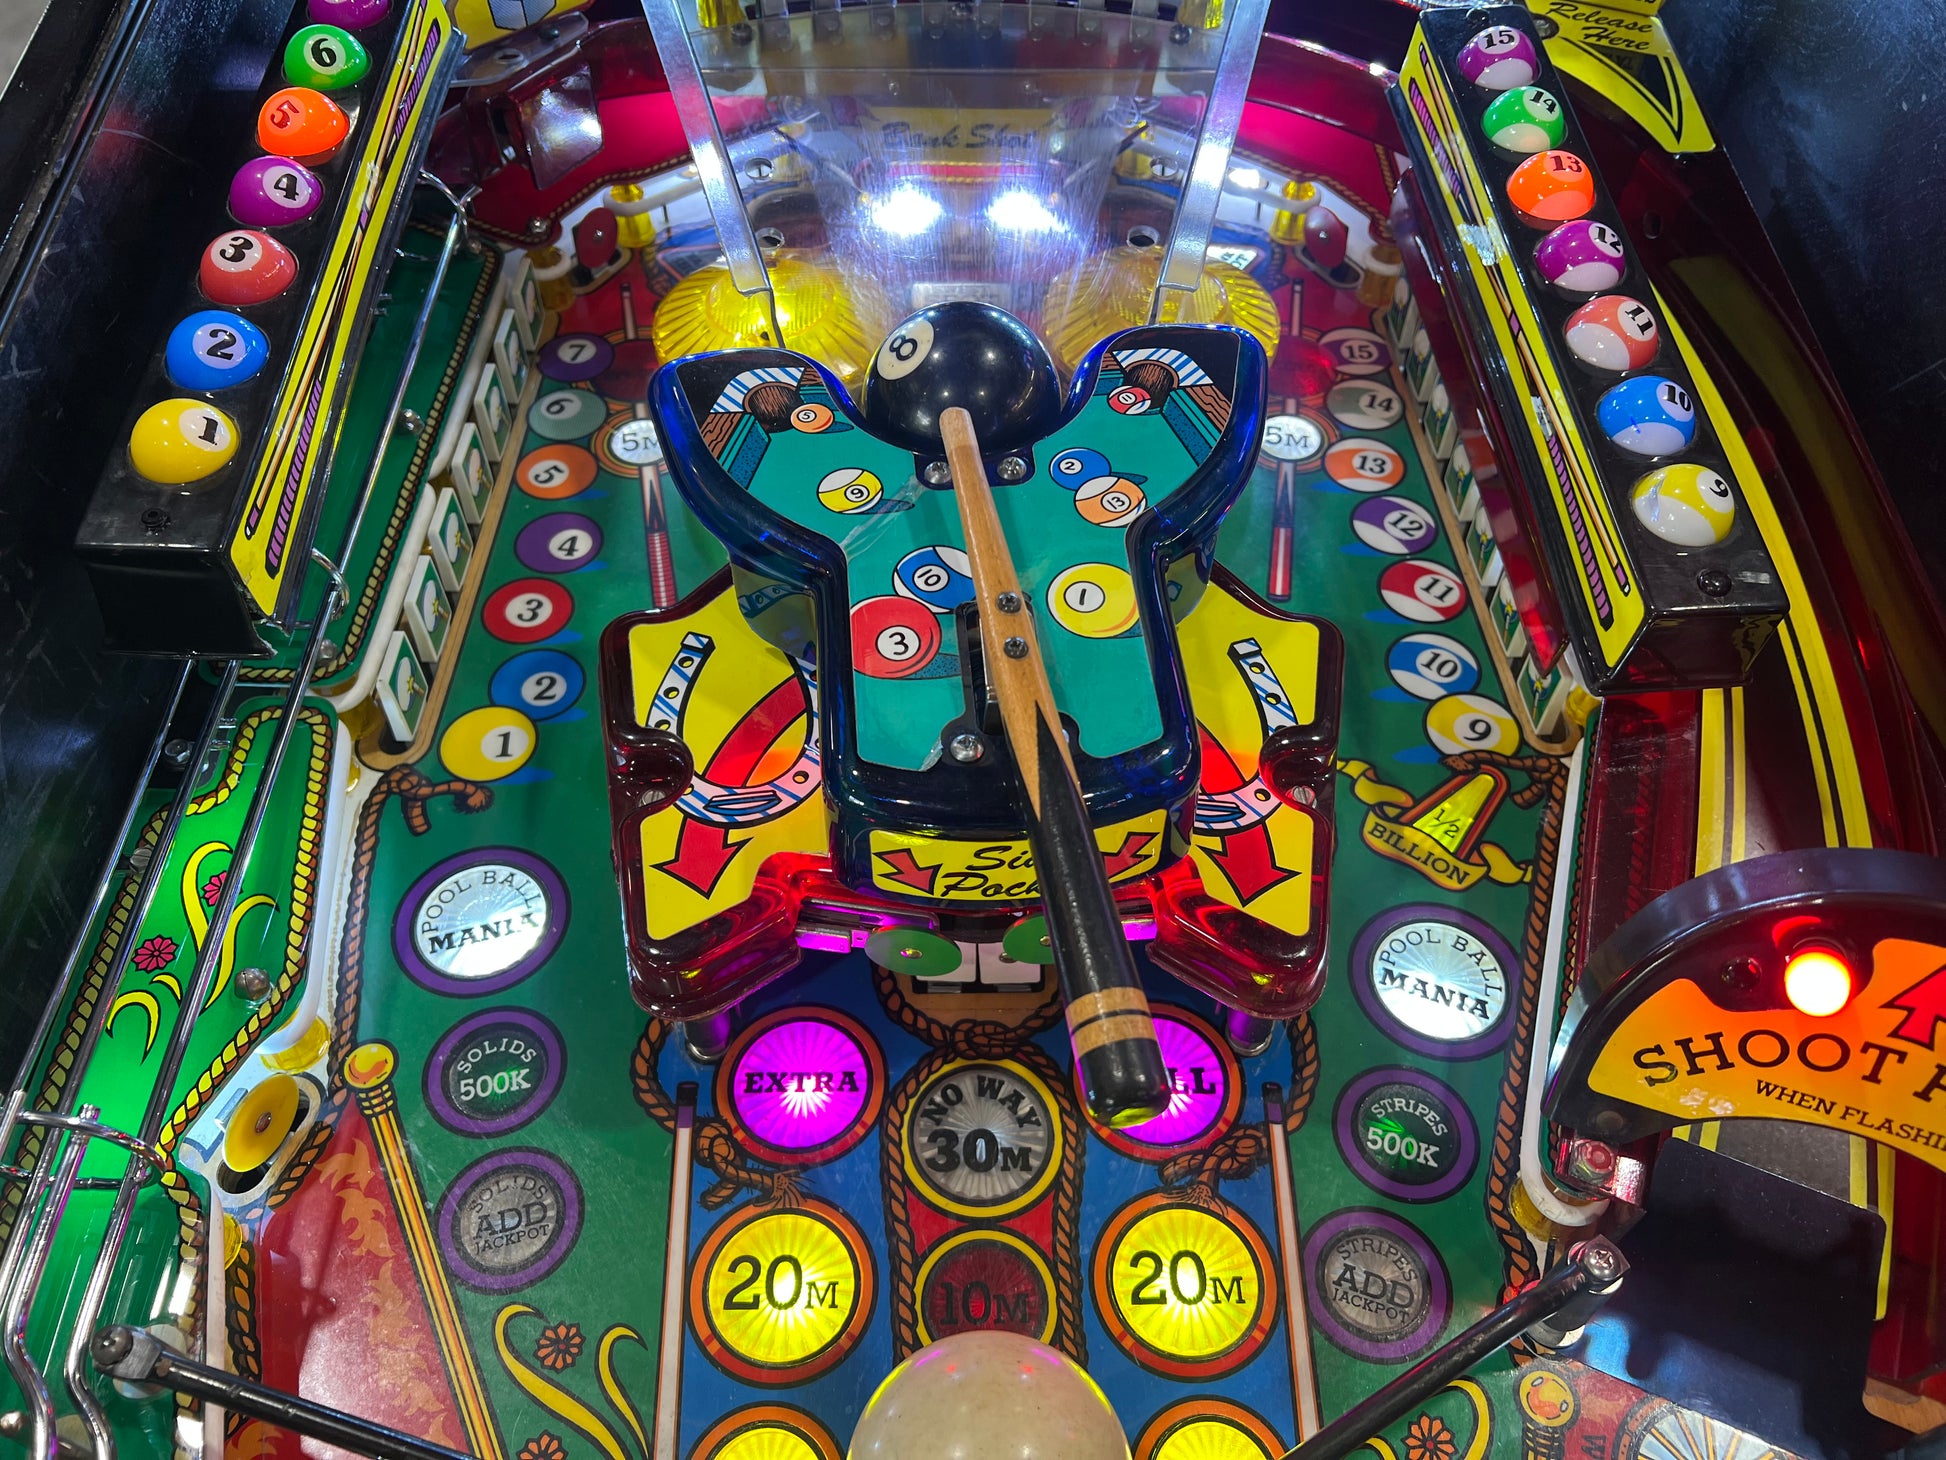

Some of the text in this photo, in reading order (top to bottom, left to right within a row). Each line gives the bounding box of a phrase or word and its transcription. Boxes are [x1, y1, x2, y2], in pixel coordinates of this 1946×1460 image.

[1545, 2, 1653, 33] Release
[1483, 29, 1516, 49] 15
[1581, 26, 1650, 50] Here
[310, 38, 337, 67] 6
[270, 100, 300, 129] 5
[1528, 89, 1556, 115] 14
[1550, 155, 1582, 174] 13
[273, 173, 300, 202] 4
[219, 236, 254, 264] 3
[1593, 226, 1623, 253] 12
[1625, 304, 1654, 336] 11
[208, 328, 235, 361] 2
[568, 344, 587, 362] 7
[890, 335, 918, 361] 8
[1346, 345, 1374, 360] 15
[546, 398, 574, 415] 6
[1366, 393, 1394, 412] 14
[1663, 383, 1693, 412] 10
[801, 411, 812, 421] 5
[198, 416, 218, 447] 1
[621, 432, 662, 451] 5M
[1264, 426, 1309, 448] 5M
[534, 464, 566, 484] 5
[1064, 461, 1076, 471] 2
[1356, 455, 1387, 474] 13
[850, 488, 864, 499] 9
[1709, 479, 1730, 498] 9
[1106, 496, 1126, 510] 13
[1388, 512, 1424, 537] 12
[557, 535, 579, 556] 4
[919, 569, 942, 585] 10
[1419, 577, 1455, 603] 11
[516, 598, 544, 623] 3
[1078, 587, 1088, 607] 1
[889, 632, 910, 656] 3
[1420, 650, 1459, 679] 10
[533, 675, 557, 701] 2
[1464, 718, 1492, 742] 9
[495, 731, 514, 758] 1
[1434, 808, 1460, 839] 1/2
[965, 845, 1034, 871] Si
[1367, 821, 1472, 886] BILLION
[940, 872, 1040, 897] Pock
[421, 870, 541, 934] POOL BALL
[429, 913, 539, 954] MANIA
[1379, 929, 1503, 997] POOL BALL
[1379, 967, 1490, 1020] MANIA
[457, 1037, 537, 1074] SOLIDS
[1633, 1029, 1907, 1087] SHOOT
[459, 1068, 532, 1101] 500K
[744, 1071, 859, 1094] EXTRA
[925, 1074, 1041, 1129] NO WAY
[1755, 1079, 1835, 1115] WHEN
[1371, 1098, 1449, 1137] STRIPES
[925, 1129, 1033, 1173] 30M
[1366, 1127, 1440, 1168] 500K
[467, 1175, 548, 1214] SOLIDS
[473, 1200, 548, 1240] ADD
[475, 1223, 551, 1255] JACKPOT
[1336, 1237, 1418, 1282] STRIPES
[723, 1255, 840, 1311] 20M
[1128, 1250, 1247, 1306] 20M
[1333, 1263, 1415, 1309] ADD
[940, 1281, 1030, 1326] 10M
[1332, 1288, 1410, 1324] JACKPOT
